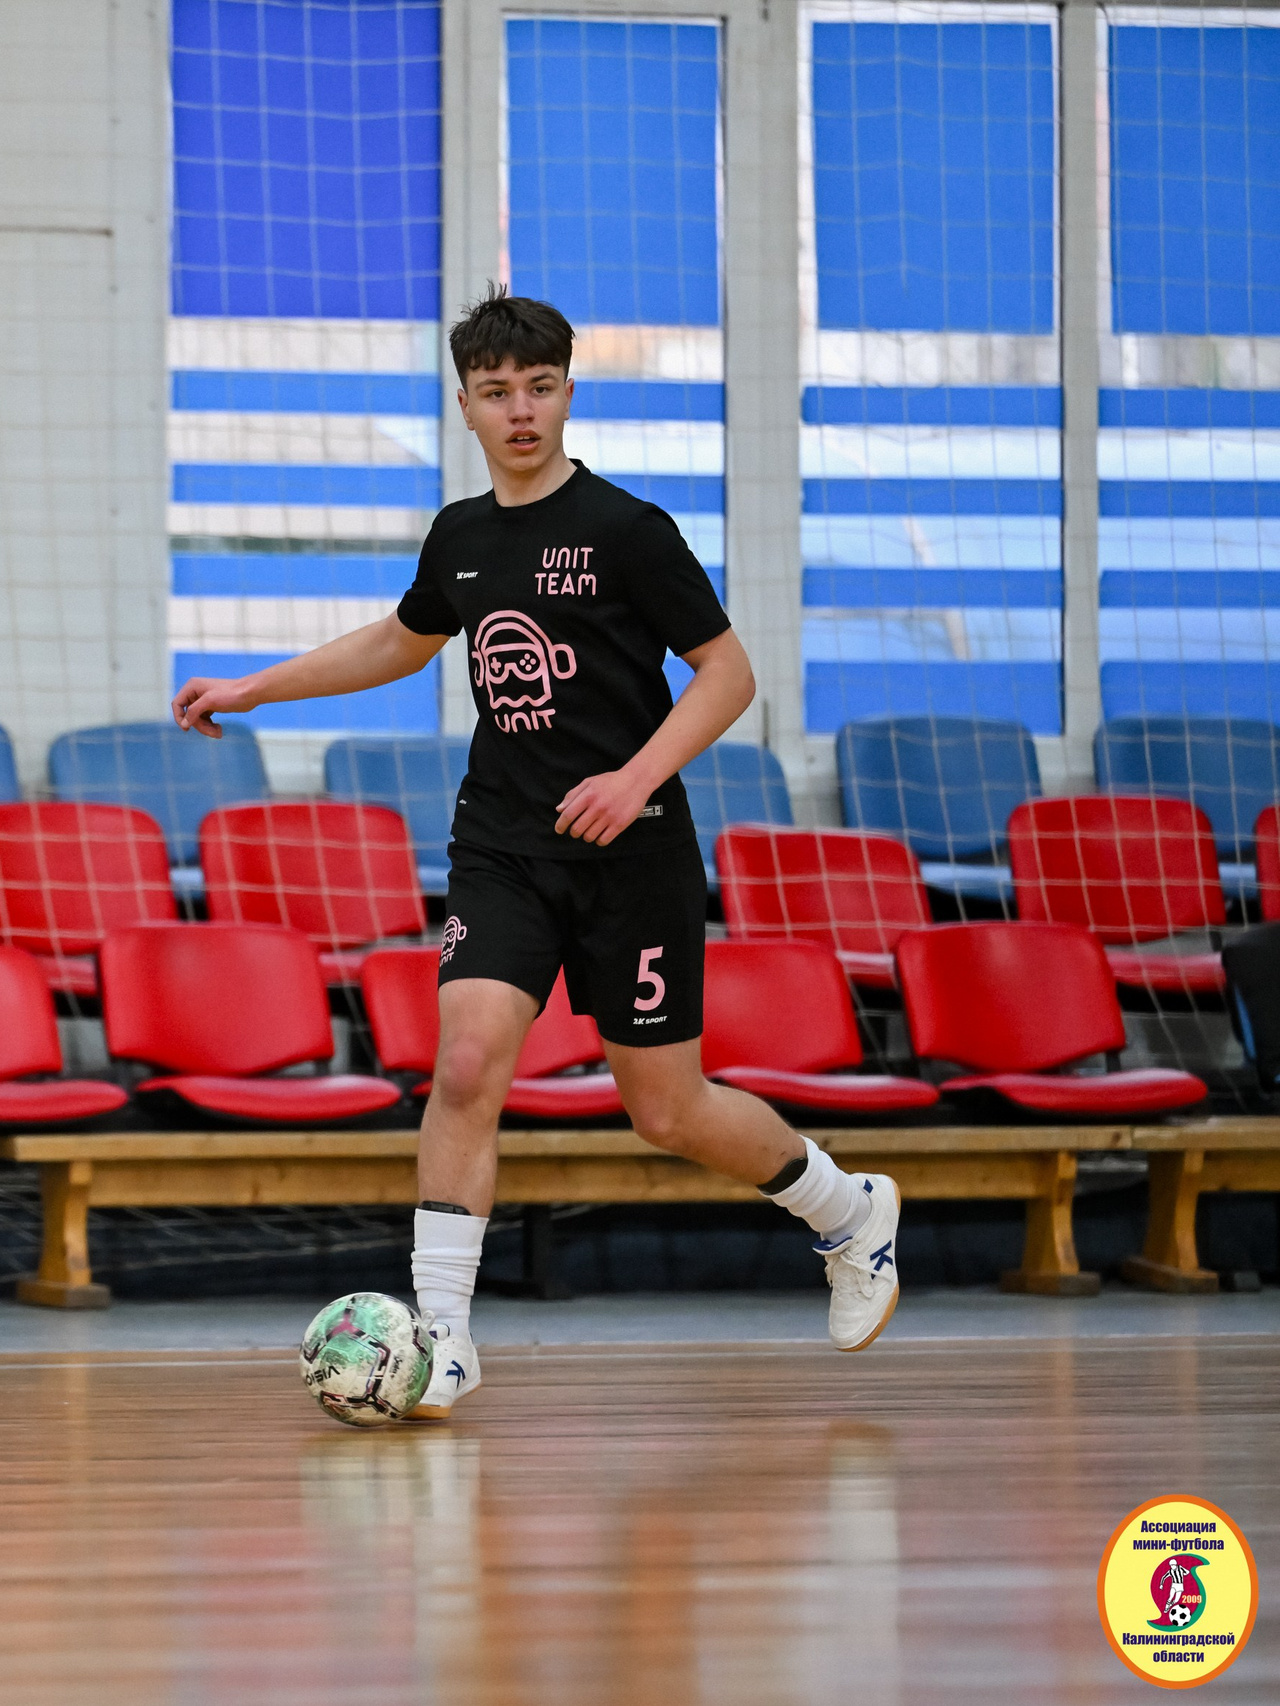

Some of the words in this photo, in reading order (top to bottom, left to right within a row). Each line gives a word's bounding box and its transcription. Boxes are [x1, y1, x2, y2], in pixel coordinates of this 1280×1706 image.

[542, 547, 593, 569] UNIT
[535, 572, 597, 595] TEAM
[494, 708, 556, 733] UNIT
[633, 946, 666, 1011] 5
[632, 1017, 646, 1025] 2K
[645, 1015, 668, 1025] SPORT
[305, 1365, 341, 1386] VISIO
